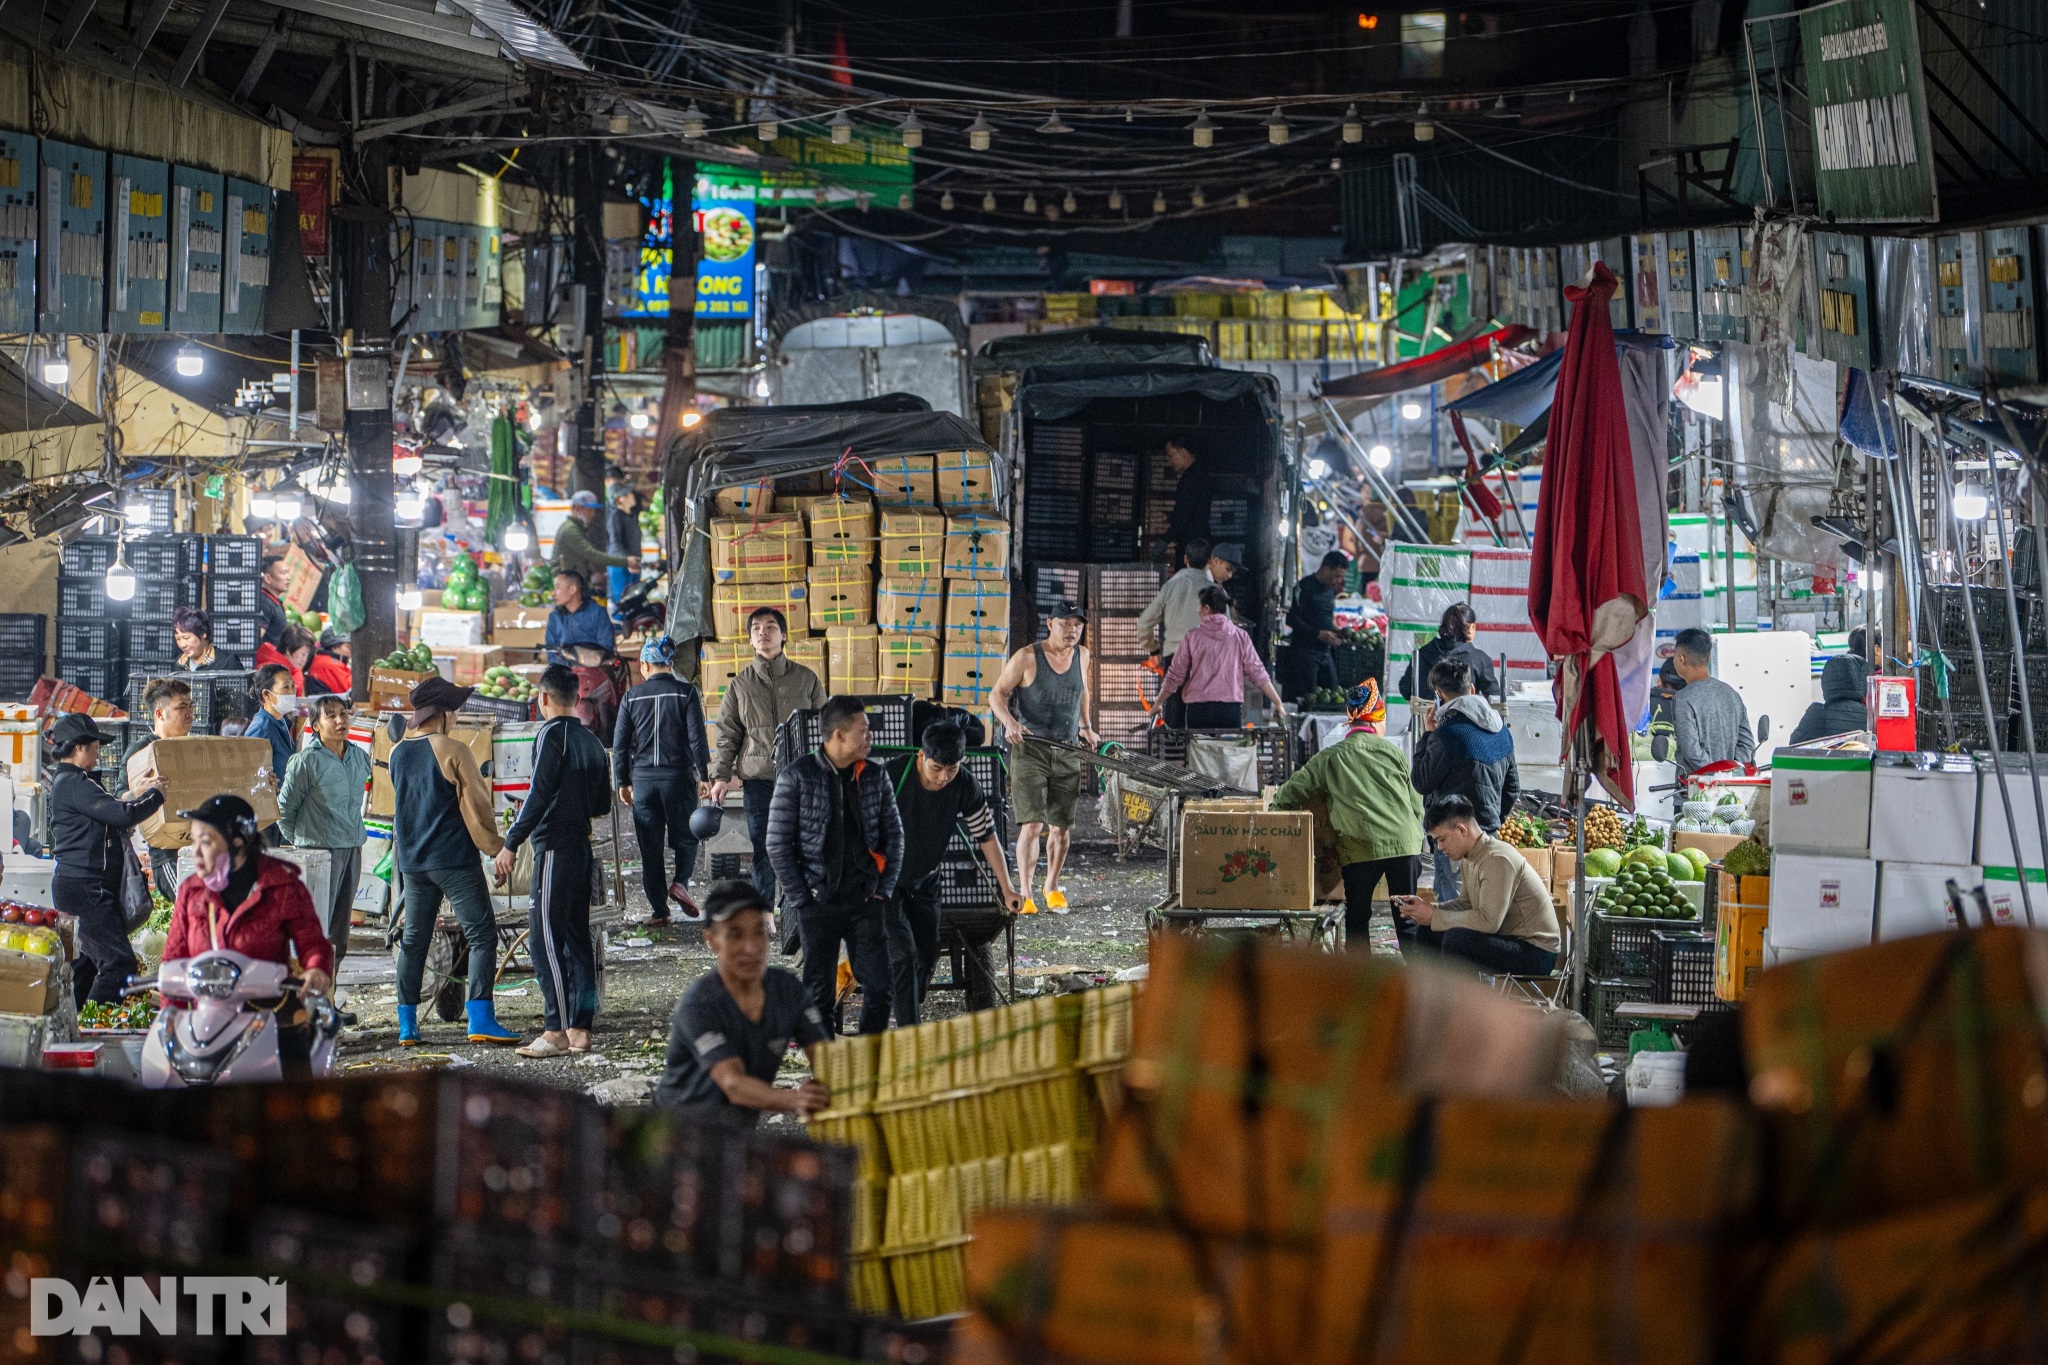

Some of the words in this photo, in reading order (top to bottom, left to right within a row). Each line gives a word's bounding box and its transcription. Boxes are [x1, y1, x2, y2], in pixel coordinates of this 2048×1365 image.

[1869, 95, 1898, 167] HOA
[1220, 825, 1239, 836] TÂY
[1270, 826, 1302, 837] CHÂU
